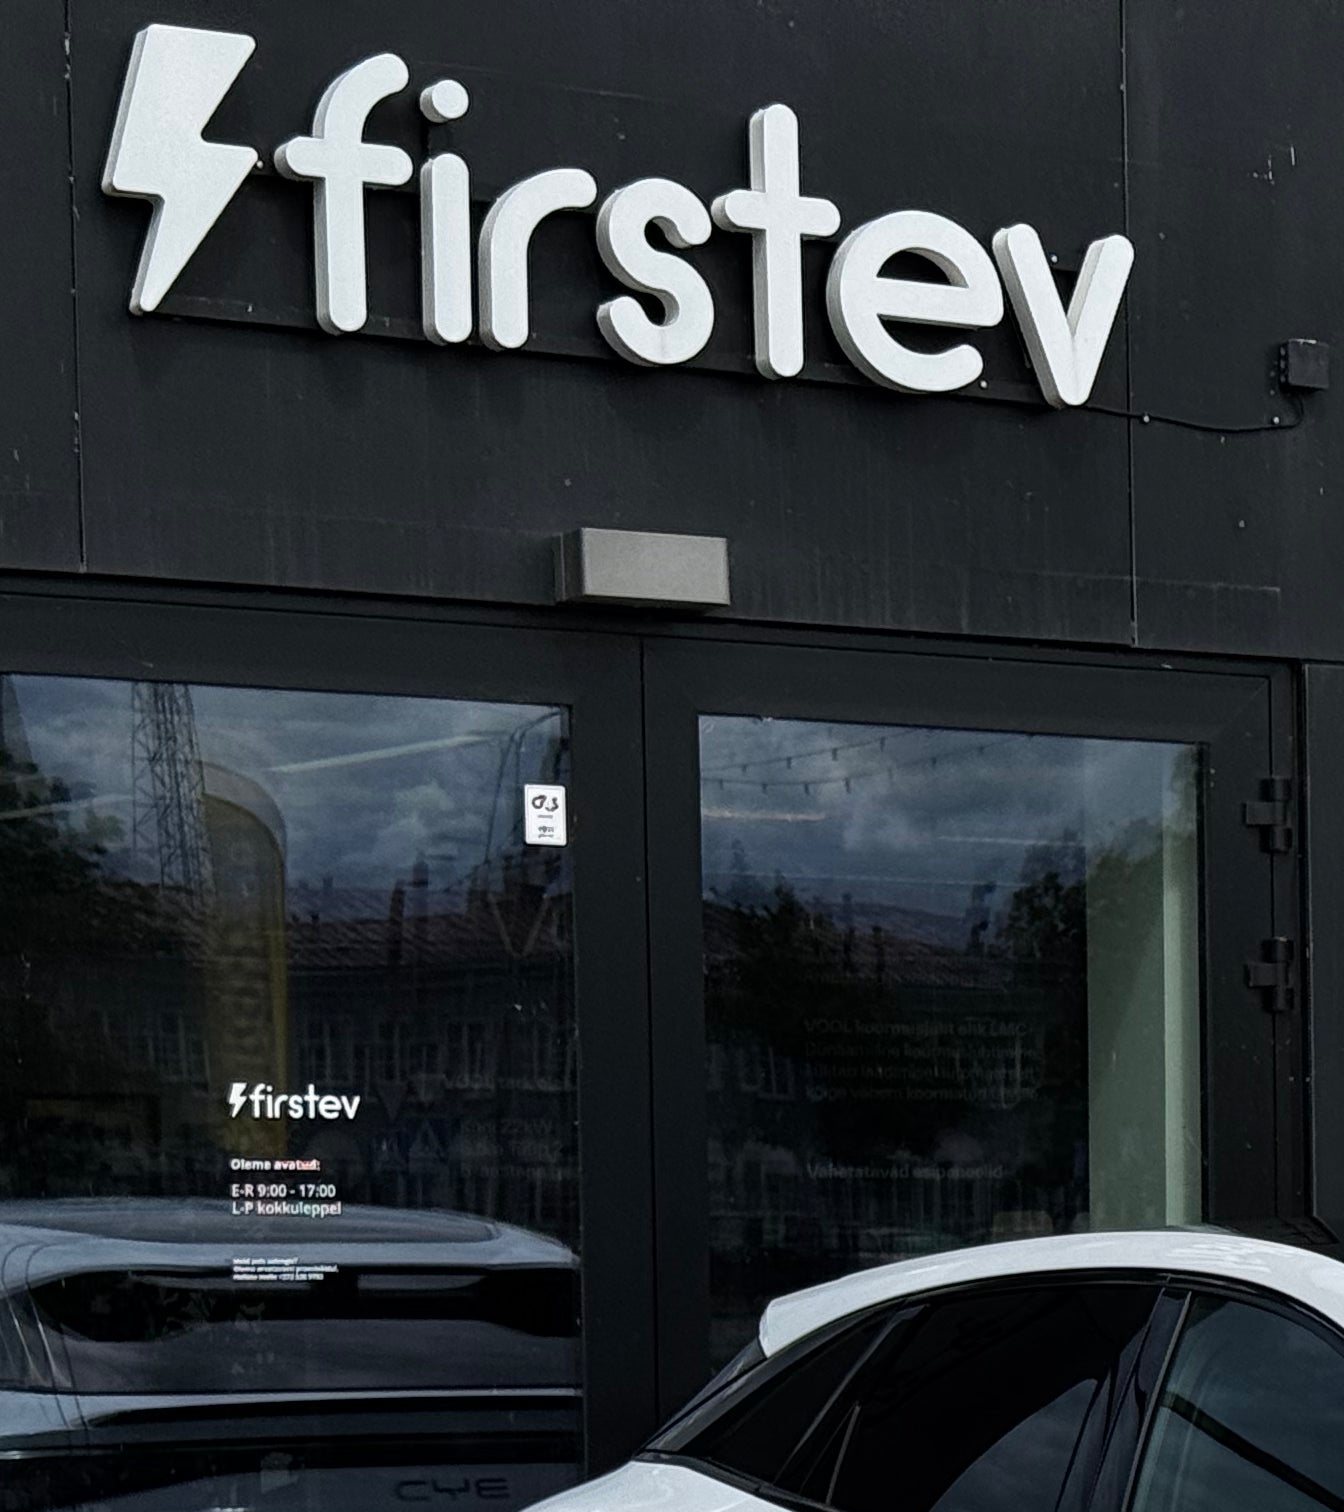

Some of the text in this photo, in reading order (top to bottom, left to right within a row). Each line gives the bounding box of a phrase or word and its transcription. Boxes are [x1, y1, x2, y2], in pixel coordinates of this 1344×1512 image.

[275, 52, 1134, 408] firstev
[249, 1083, 360, 1119] firstev
[230, 1158, 271, 1171] Oleme
[231, 1184, 254, 1198] E-R
[257, 1184, 287, 1198] 9:00
[299, 1184, 336, 1198] 17:00
[231, 1201, 342, 1218] L-P kokkuleppel
